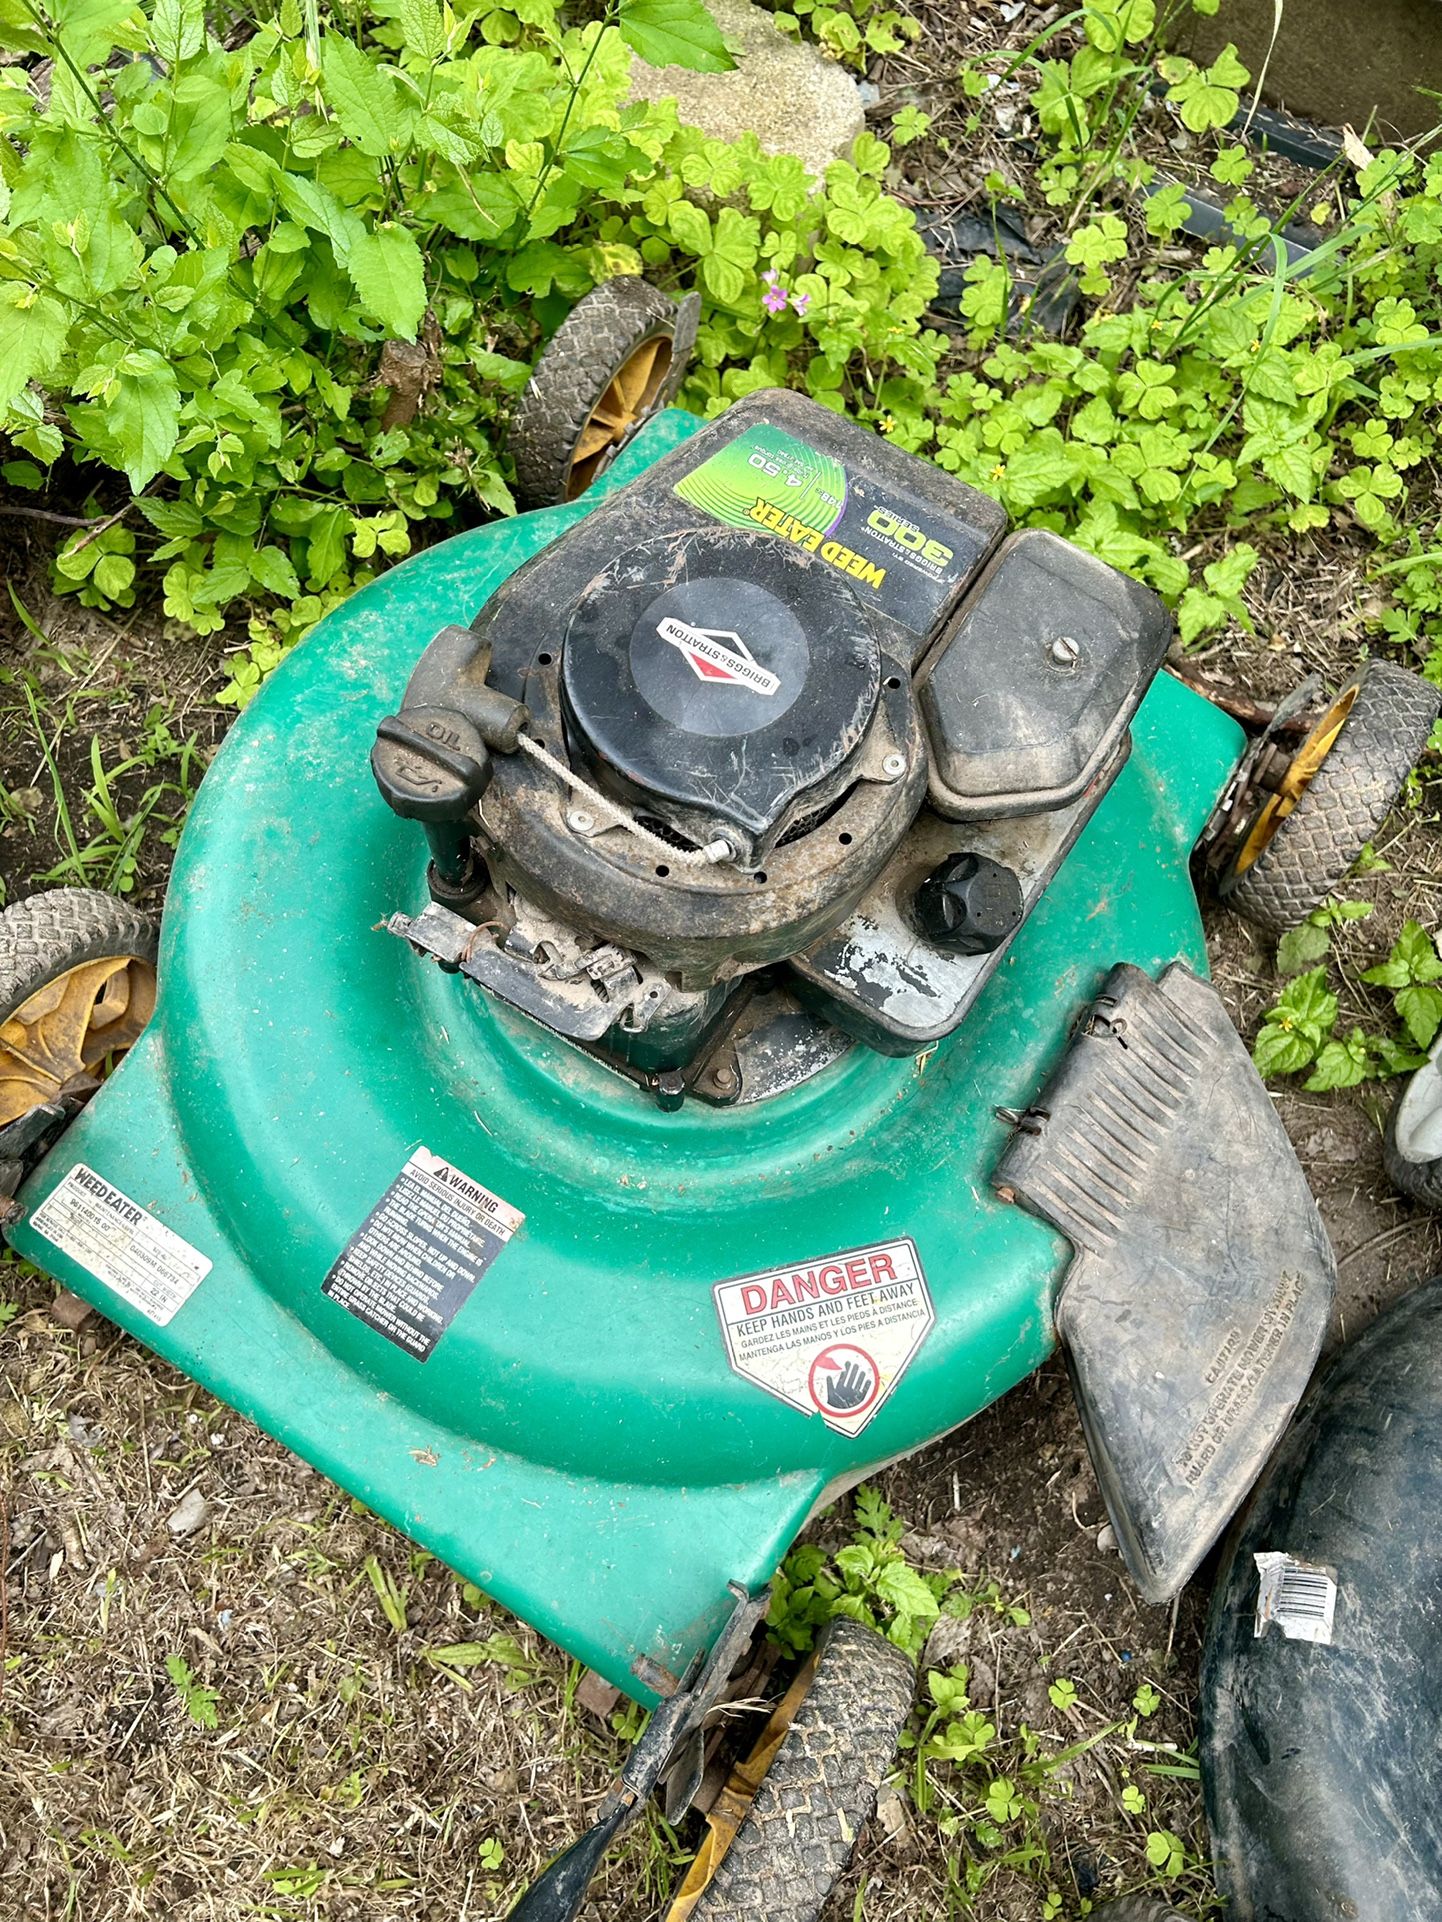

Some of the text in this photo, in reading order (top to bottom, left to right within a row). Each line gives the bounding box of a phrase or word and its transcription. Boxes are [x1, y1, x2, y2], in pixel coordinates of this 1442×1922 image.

[748, 451, 804, 487] 4.50
[864, 506, 955, 568] 300
[876, 505, 920, 533] SERIES
[816, 536, 888, 589] WEED
[426, 722, 461, 751] OIL
[73, 1167, 110, 1199] WEED
[103, 1190, 144, 1226] EATER
[393, 1191, 409, 1206] READ
[406, 1200, 419, 1212] THE
[409, 1168, 505, 1236] AVOID SERIOUS INJURY OR DEATH
[448, 1173, 499, 1214] WARNING
[357, 1239, 371, 1252] AND
[362, 1233, 379, 1247] LOOK
[392, 1253, 406, 1265] AND
[421, 1273, 444, 1292] BEFORE
[365, 1256, 386, 1273] SAFETY
[378, 1212, 388, 1222] GO
[426, 1245, 440, 1257] NOT
[437, 1252, 448, 1263] UP
[445, 1258, 459, 1271] AND
[380, 1224, 394, 1237] NOT
[420, 1251, 448, 1274] CHILDREN
[445, 1268, 456, 1279] OR
[385, 1290, 401, 1304] THAT
[398, 1299, 418, 1316] COULD
[389, 1283, 408, 1299] PLACE
[405, 1294, 419, 1306] AND
[736, 1282, 915, 1337] KEEP HANDS AND FEET AWAY
[739, 1253, 897, 1316] DANGER
[334, 1276, 344, 1286] DO
[341, 1281, 354, 1293] NOT
[352, 1288, 377, 1308] OPERATE
[417, 1333, 431, 1346] THE
[364, 1306, 389, 1327] CATCHER
[387, 1322, 397, 1333] OR
[395, 1328, 408, 1340] THE
[405, 1335, 426, 1352] GUARD
[738, 1342, 785, 1361] MANTENGA
[784, 1338, 802, 1349] LAS
[802, 1331, 832, 1345] MANOS
[840, 1325, 857, 1336] LOS
[857, 1320, 876, 1332] PIES
[884, 1308, 925, 1325] DISTANCIA
[740, 1333, 775, 1349] GARDEZ
[774, 1329, 791, 1340] LES
[791, 1322, 818, 1336] MAINS
[818, 1319, 830, 1329] ET
[830, 1315, 846, 1326] LES
[846, 1309, 871, 1322] PIEDS
[878, 1297, 918, 1314] DISTANCE
